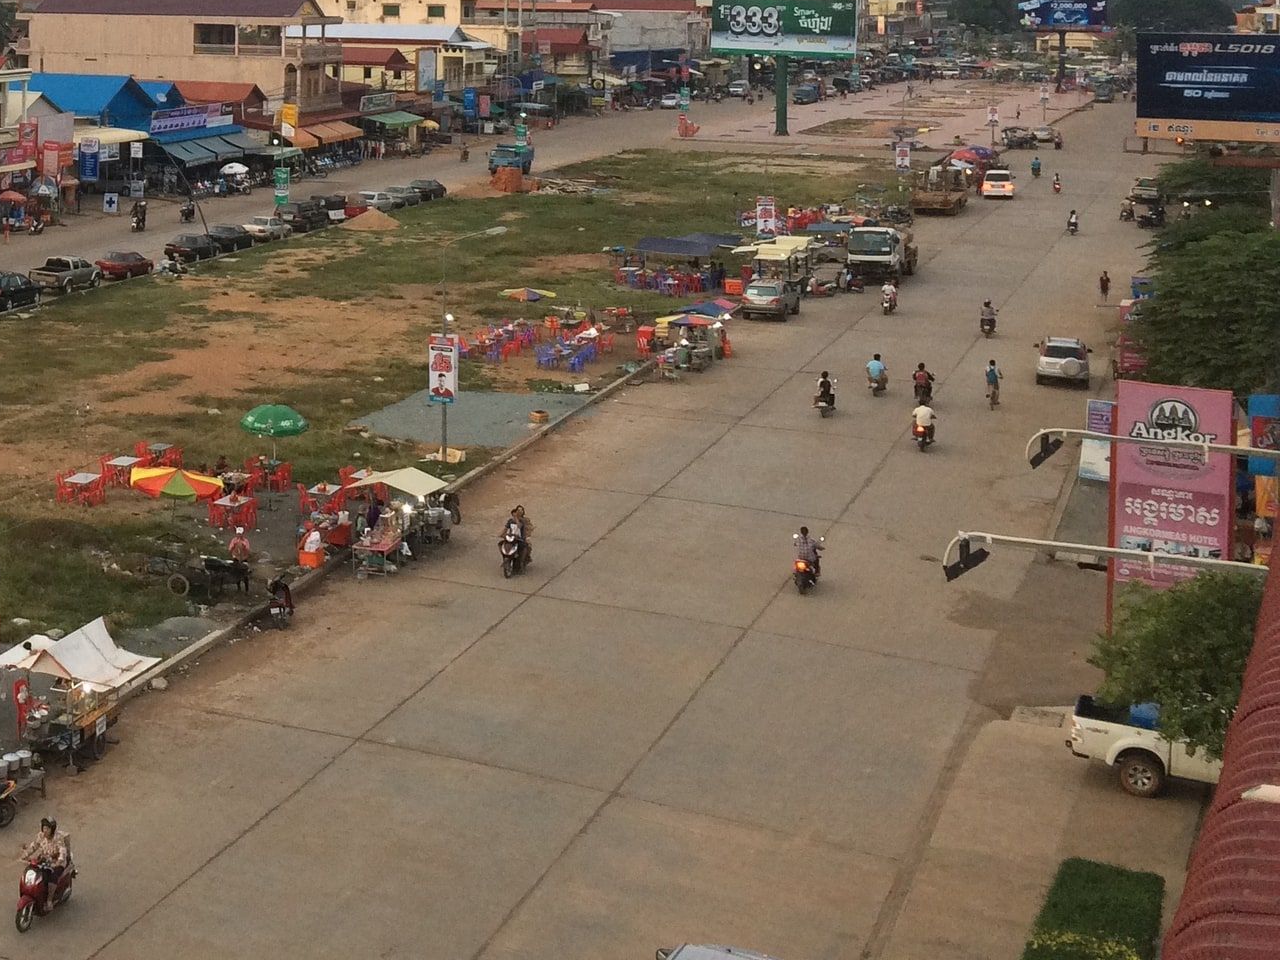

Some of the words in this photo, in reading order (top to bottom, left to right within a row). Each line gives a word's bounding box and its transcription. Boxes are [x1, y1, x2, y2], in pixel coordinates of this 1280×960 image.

[730, 5, 779, 34] 333
[1214, 43, 1276, 54] L5018
[1183, 89, 1202, 98] 50
[1131, 420, 1217, 444] Angkor
[1124, 496, 1220, 527] អង្គរមាស
[1188, 534, 1221, 547] HOTEL
